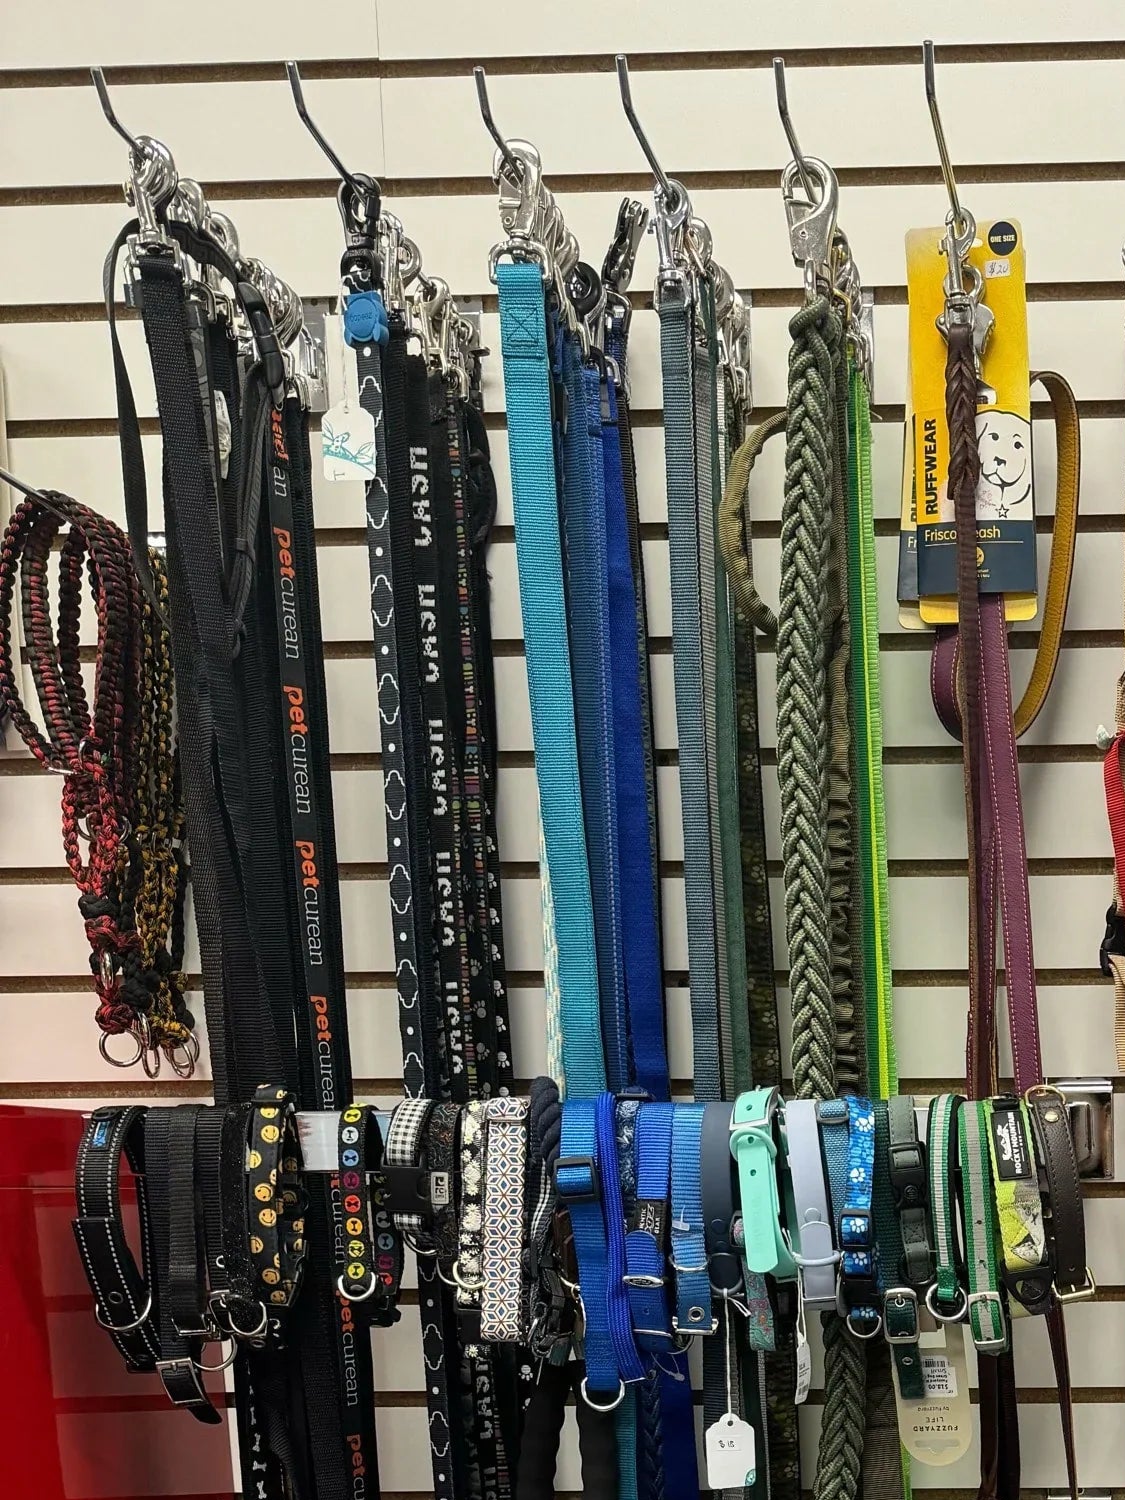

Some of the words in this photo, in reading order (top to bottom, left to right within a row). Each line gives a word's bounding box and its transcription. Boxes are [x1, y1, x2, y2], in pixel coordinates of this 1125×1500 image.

[924, 418, 938, 515] RUFFWEAR
[924, 528, 957, 542] Frisco
[976, 526, 1001, 539] eash
[272, 526, 301, 660] petcurean
[283, 685, 312, 814] petcurean
[295, 840, 323, 966] petcurean
[310, 995, 336, 1111] petcurean
[1007, 1112, 1018, 1148] MOUNTAIN
[1012, 1148, 1022, 1174] ROCKY
[335, 1291, 360, 1407] petcurean
